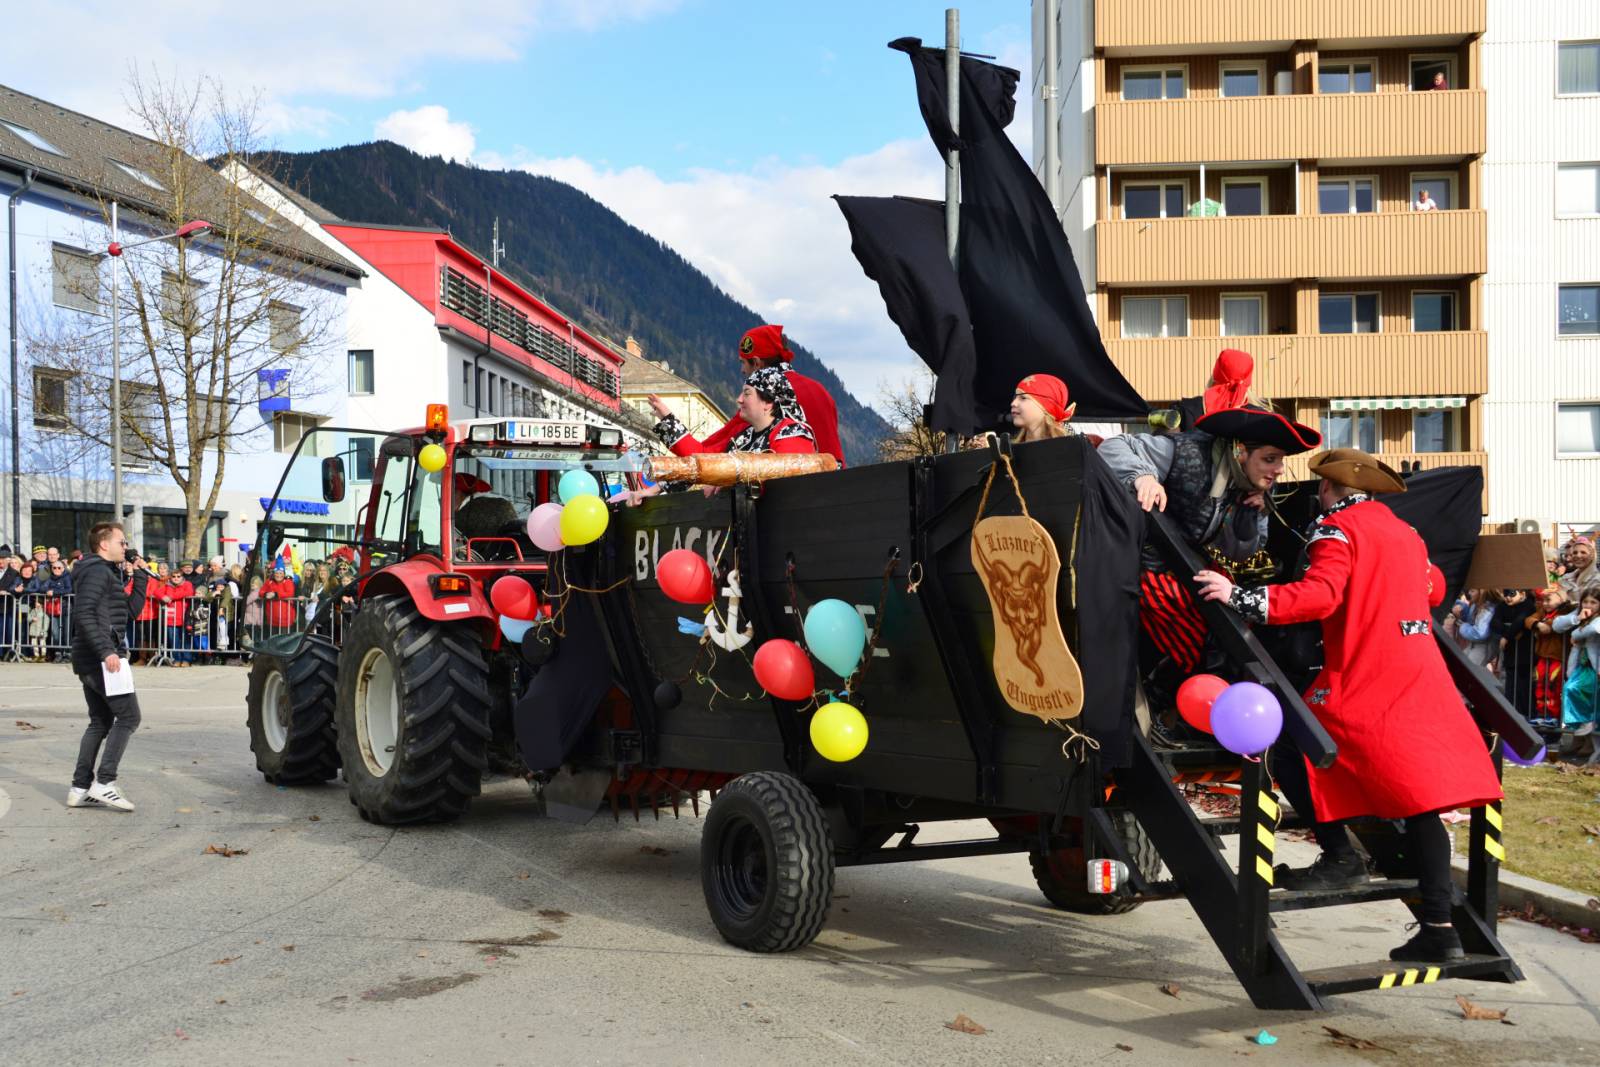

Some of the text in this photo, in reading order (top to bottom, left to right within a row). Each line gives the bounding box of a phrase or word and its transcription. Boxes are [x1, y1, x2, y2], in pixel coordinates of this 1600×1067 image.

[521, 425, 531, 437] LI
[541, 426, 561, 438] 185
[564, 426, 579, 439] BE
